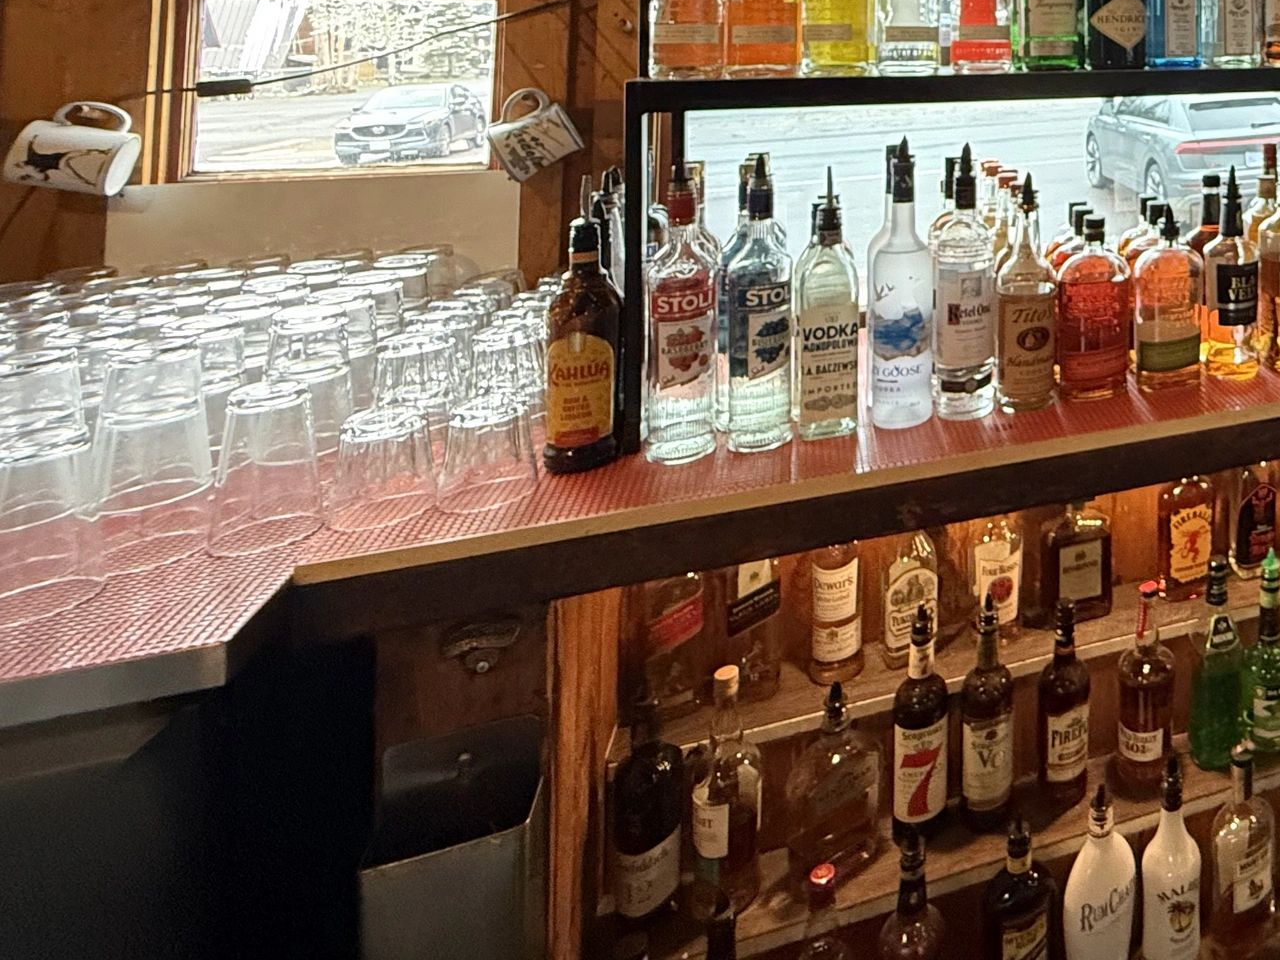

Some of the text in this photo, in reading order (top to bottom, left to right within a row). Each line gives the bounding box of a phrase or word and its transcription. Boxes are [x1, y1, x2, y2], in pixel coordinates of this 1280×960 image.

[1231, 275, 1256, 290] BLA
[746, 286, 790, 307] STOL
[802, 322, 859, 342] VODKA
[882, 363, 924, 378] GOOSE
[901, 742, 943, 818] 7
